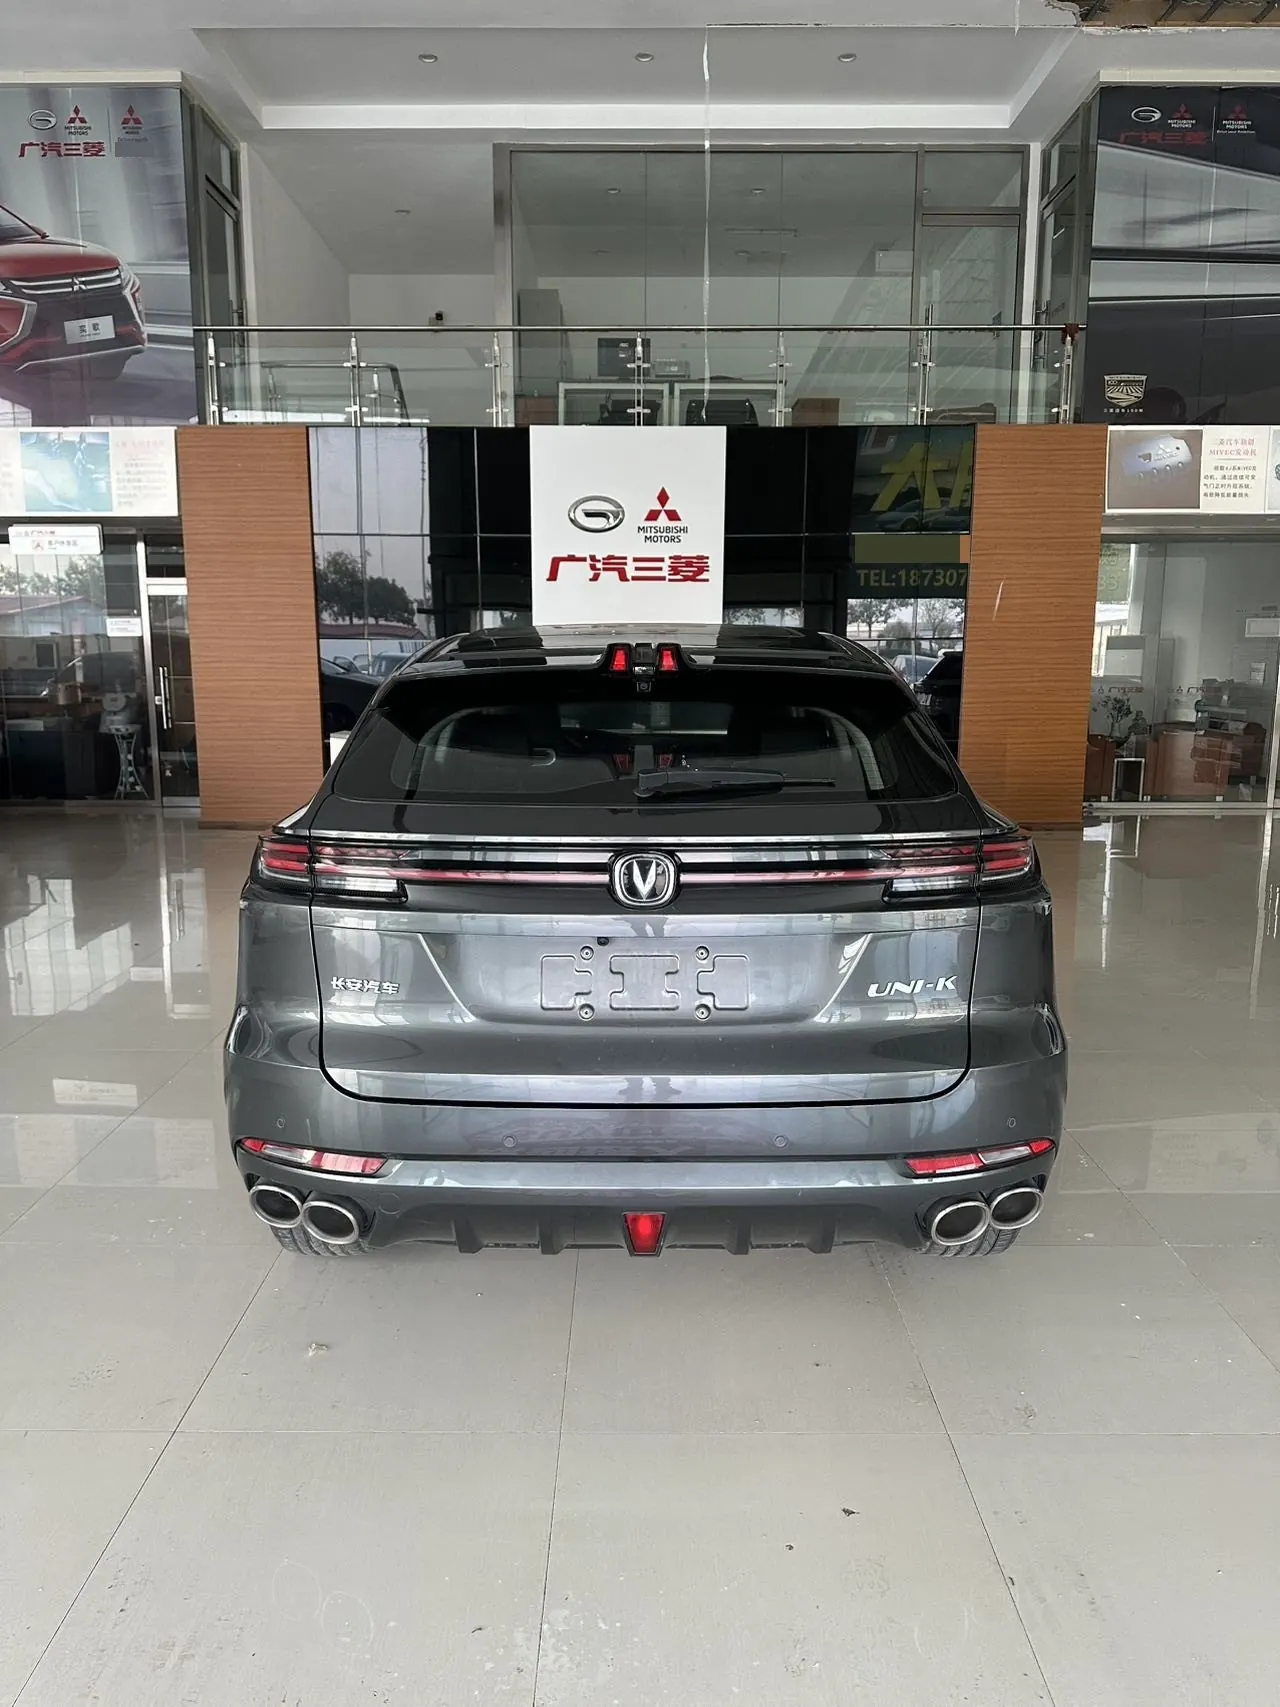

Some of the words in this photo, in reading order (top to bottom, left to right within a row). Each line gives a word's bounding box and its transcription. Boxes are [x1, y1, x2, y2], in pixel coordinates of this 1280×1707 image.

[18, 141, 106, 157] 广汽三菱
[637, 525, 689, 534] MITSUBISHI
[644, 535, 682, 543] MOTORS
[546, 554, 710, 582] 广汽三菱
[856, 568, 968, 587] TEL:187307
[330, 976, 399, 994] 长安汽车
[867, 975, 958, 997] UNI-K
